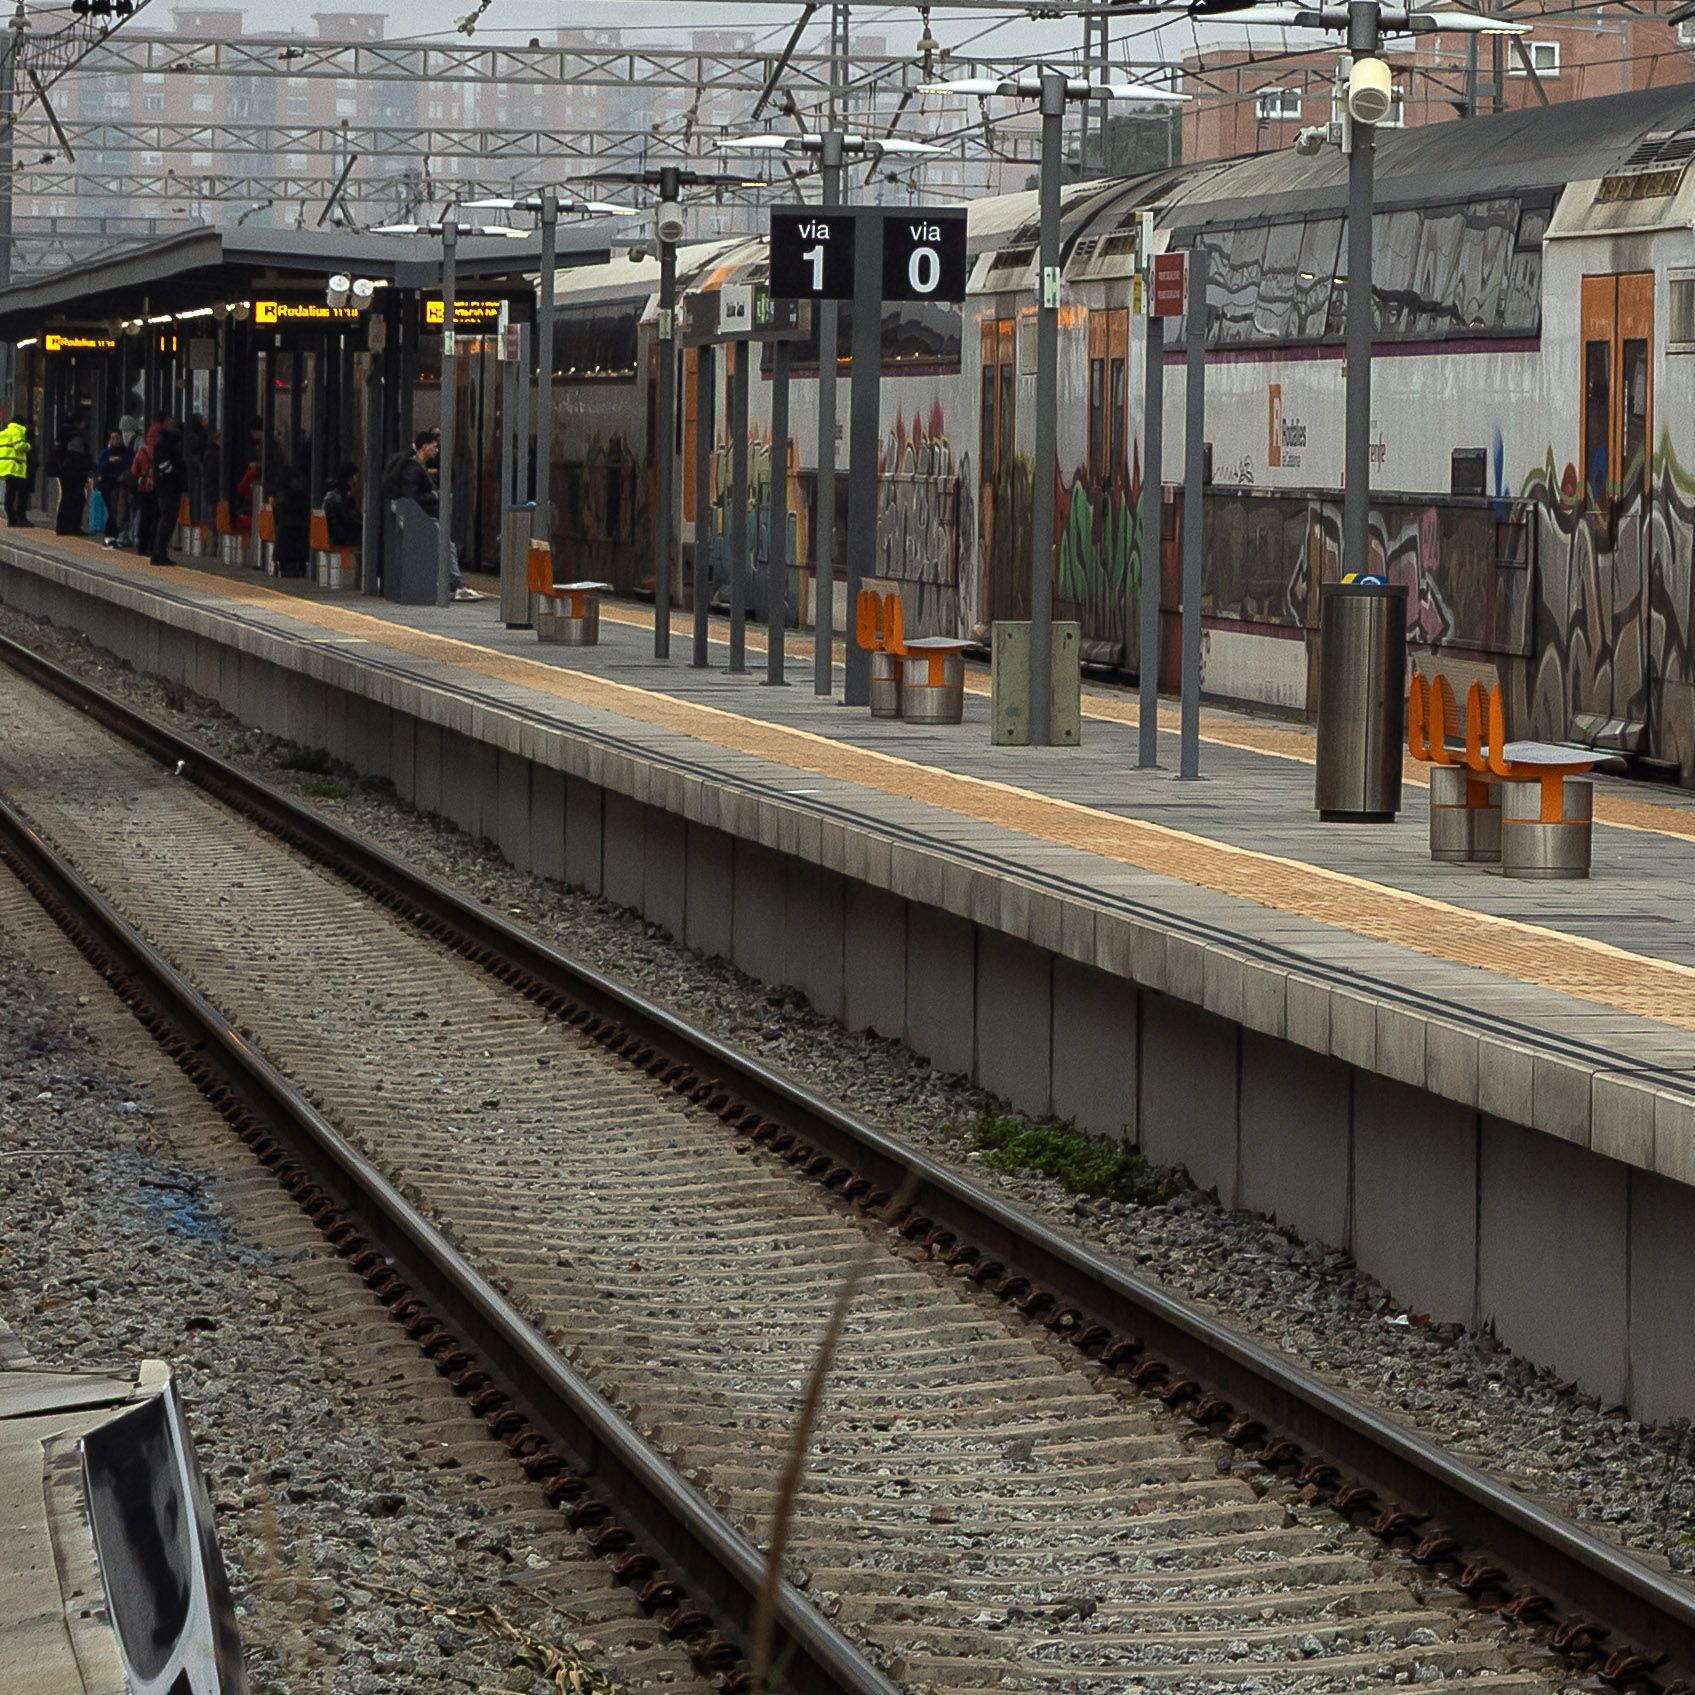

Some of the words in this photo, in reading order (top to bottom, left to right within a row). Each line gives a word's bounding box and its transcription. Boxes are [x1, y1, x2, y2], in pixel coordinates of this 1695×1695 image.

[799, 219, 830, 240] via
[910, 221, 941, 242] via
[803, 245, 824, 290] 1
[908, 247, 940, 293] 0
